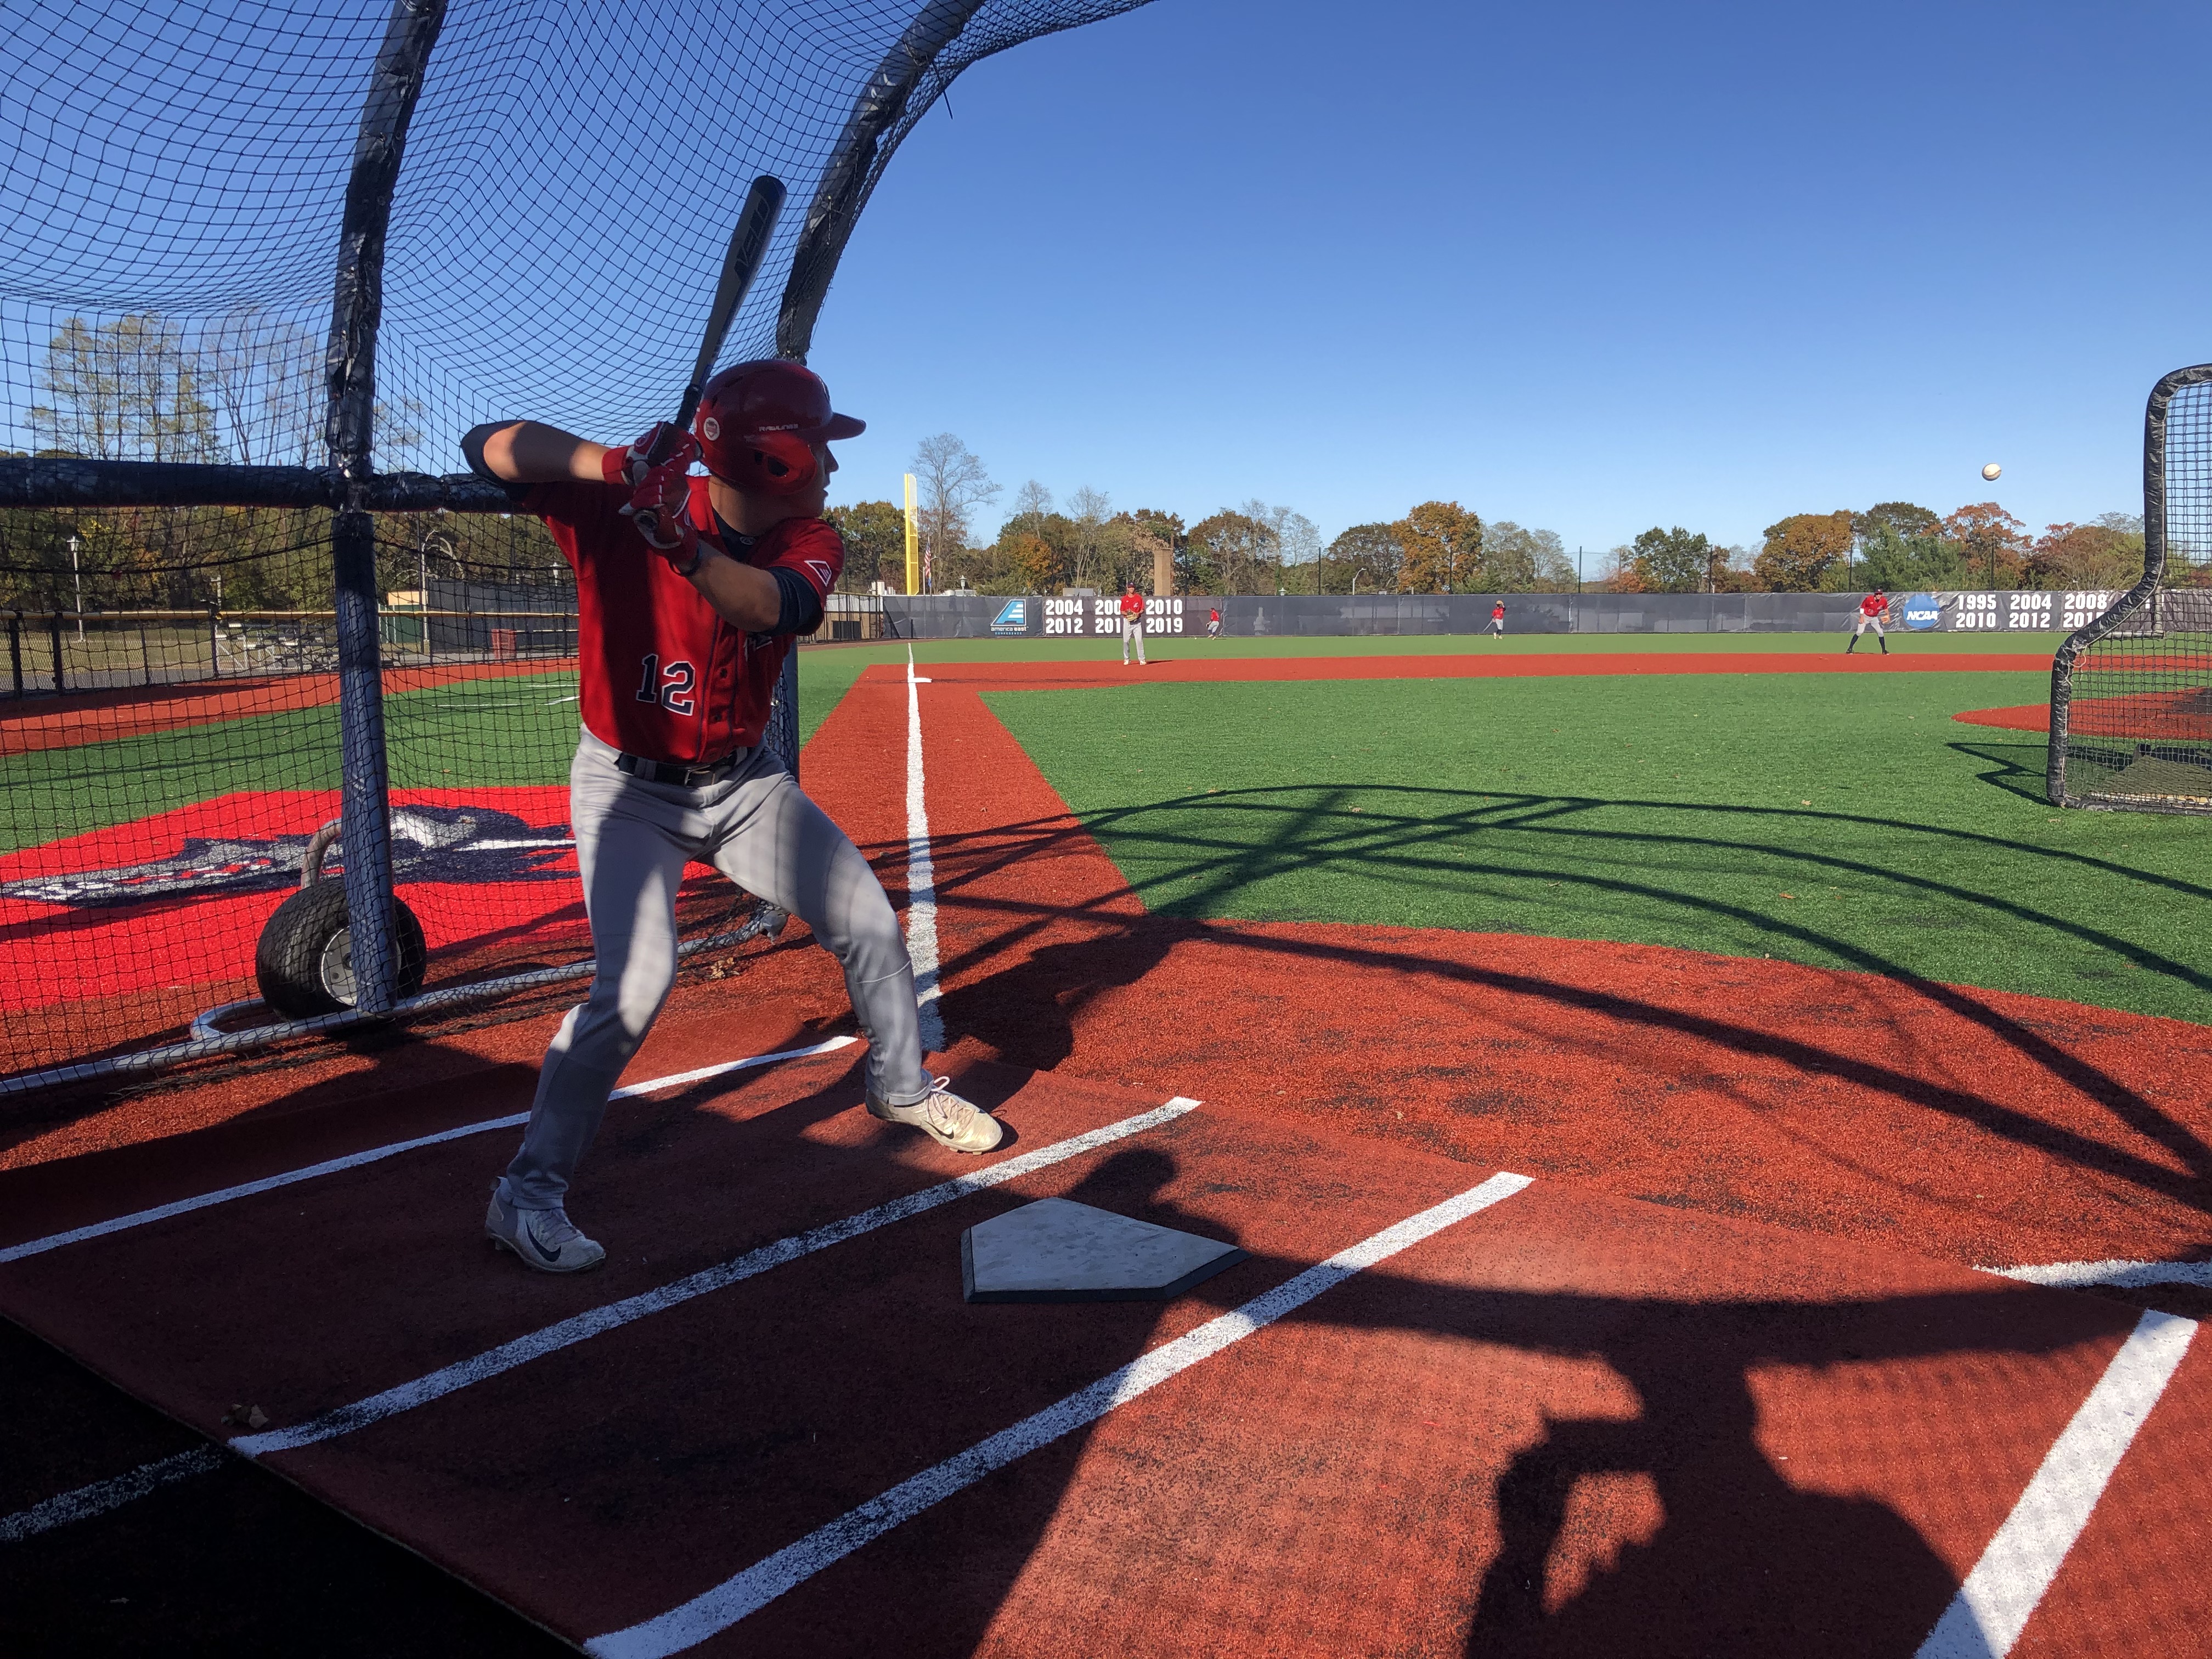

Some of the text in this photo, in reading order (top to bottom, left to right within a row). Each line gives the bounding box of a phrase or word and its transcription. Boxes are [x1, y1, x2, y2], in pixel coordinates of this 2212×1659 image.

[1046, 600, 1182, 615] 2004 200 2010
[1958, 594, 1996, 610] 1995
[2011, 594, 2052, 610] 2004
[2064, 594, 2107, 610] 2008
[1906, 611, 1938, 620] NCAA
[1955, 612, 1996, 628] 2010
[2009, 612, 2050, 628] 2012
[1046, 617, 1183, 633] 2012 201 2019
[636, 653, 696, 716] 12
